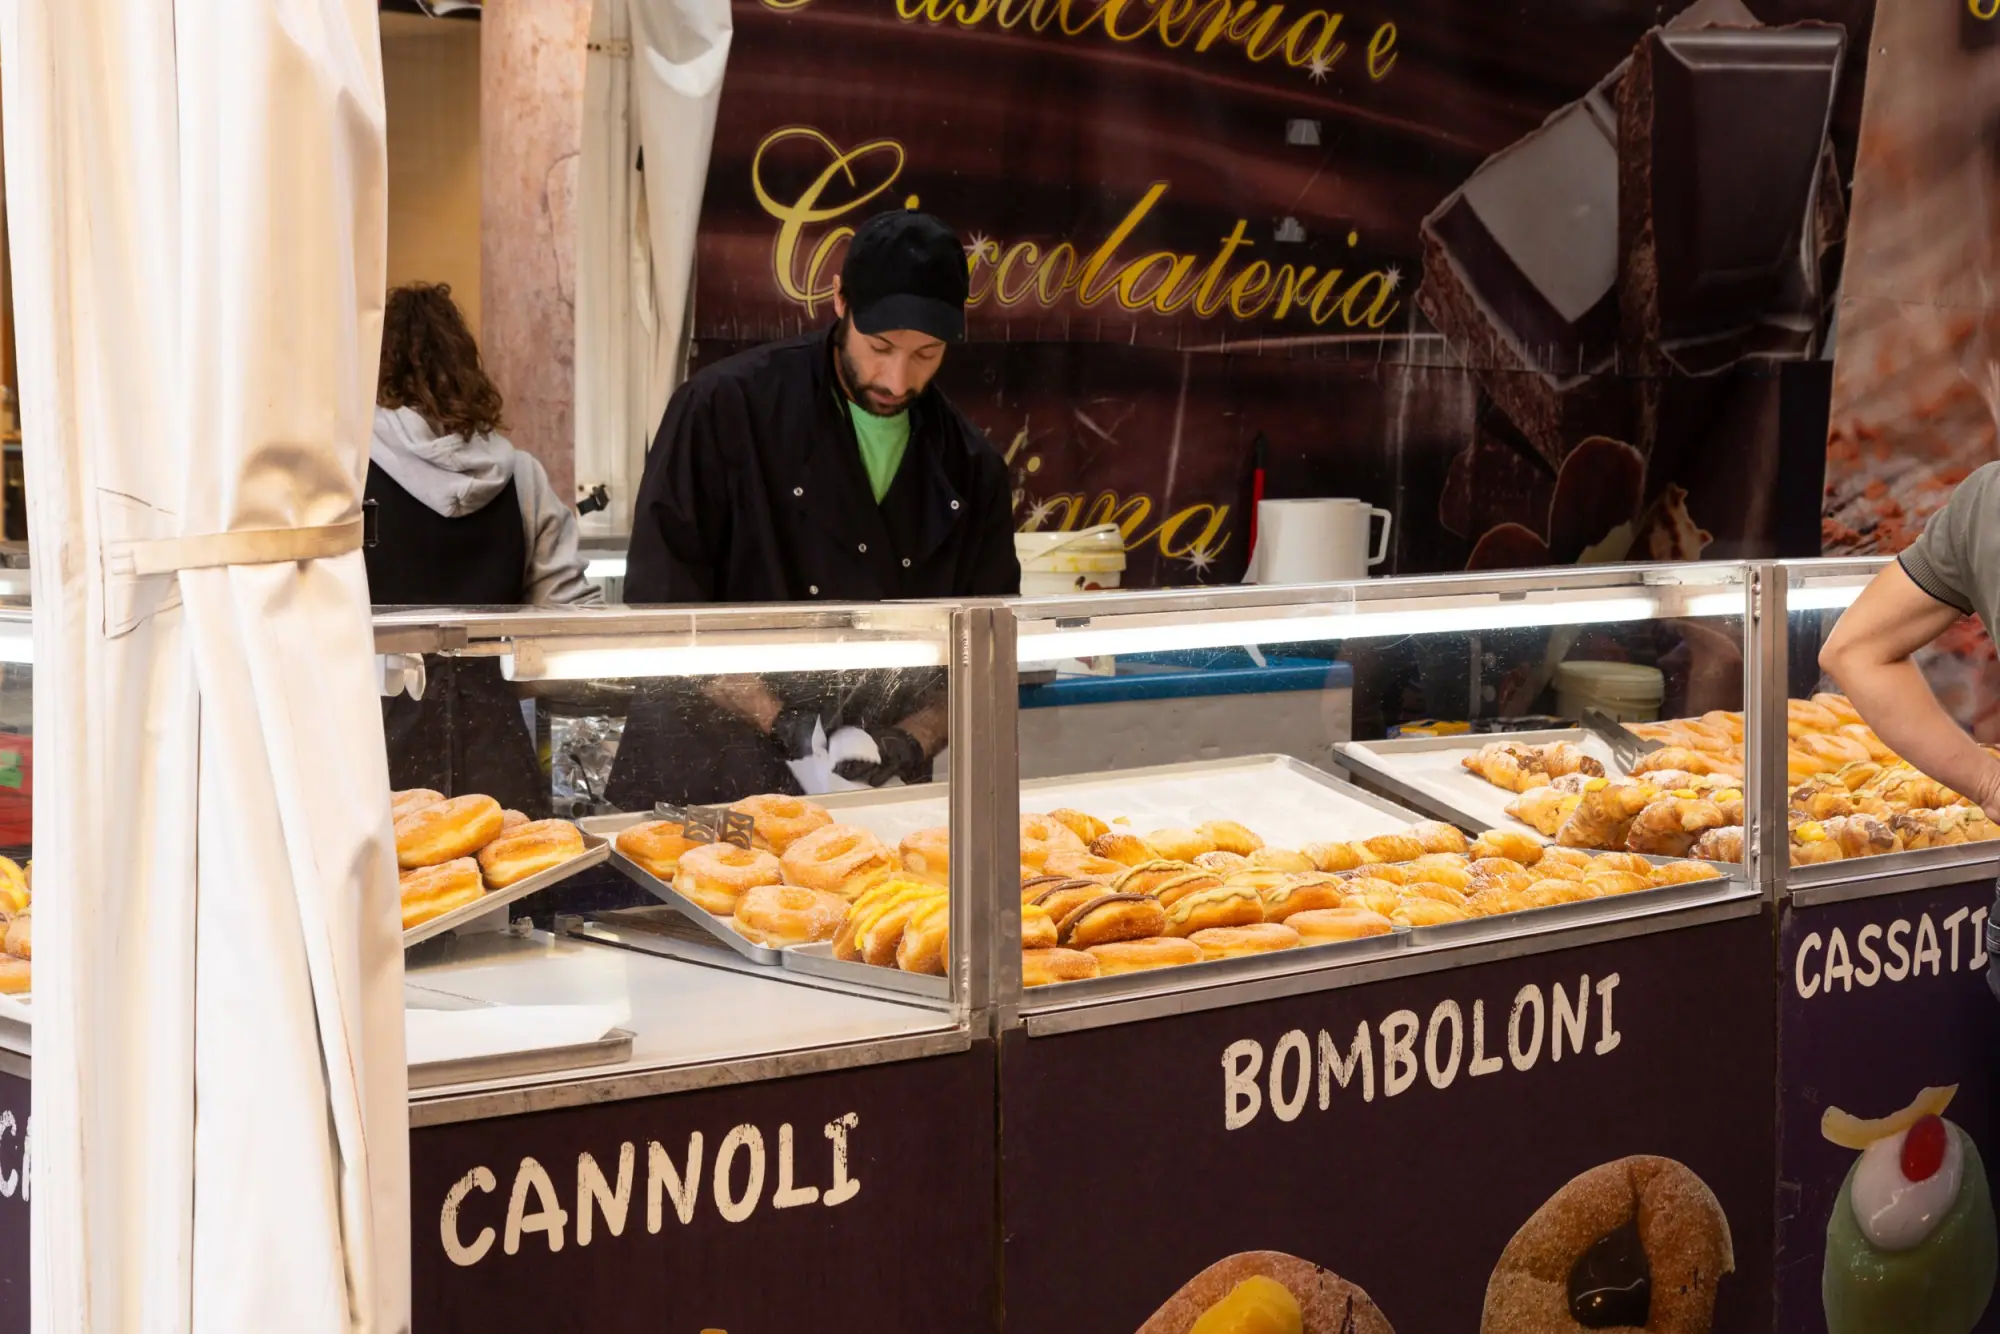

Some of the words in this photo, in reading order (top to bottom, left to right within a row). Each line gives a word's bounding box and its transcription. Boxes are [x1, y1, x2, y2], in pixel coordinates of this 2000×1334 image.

[1368, 22, 1397, 80] e
[752, 127, 1400, 329] Cccolateria
[1221, 972, 1621, 1131] BOMBOLONI
[440, 1112, 861, 1266] CANNOLI
